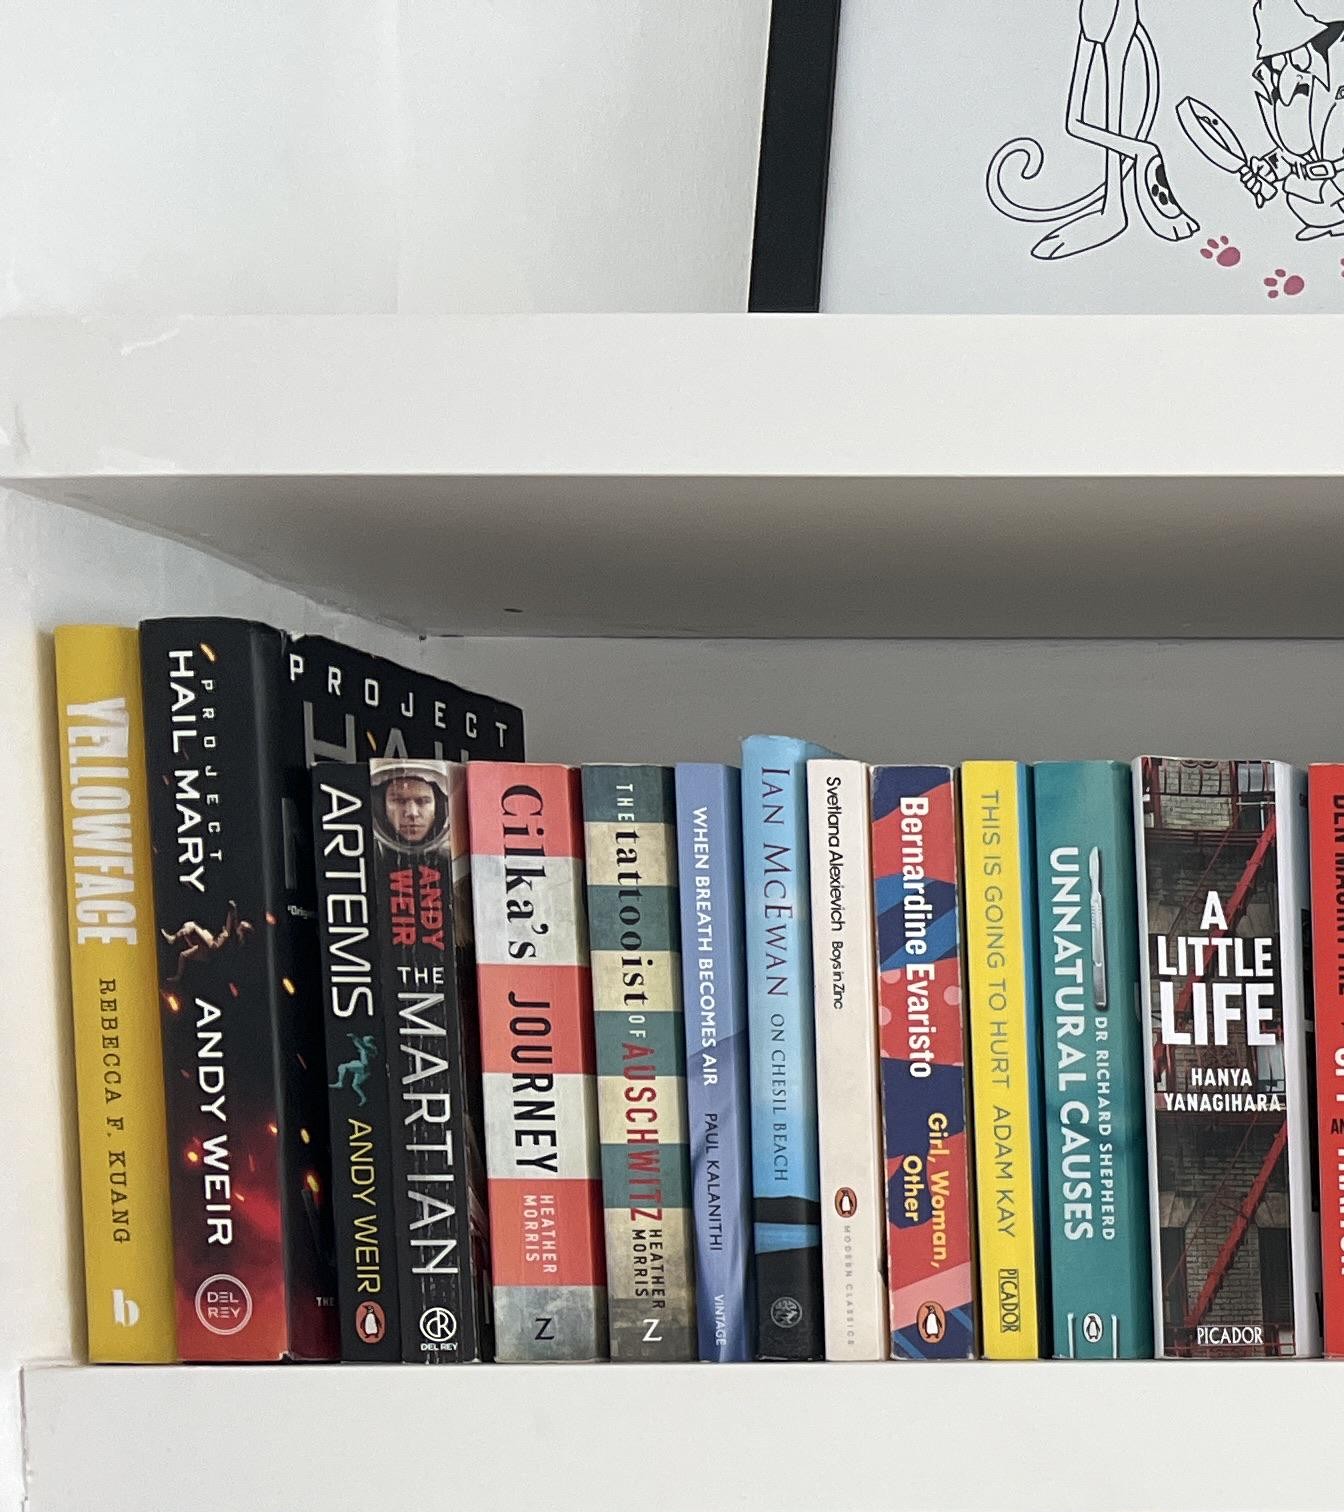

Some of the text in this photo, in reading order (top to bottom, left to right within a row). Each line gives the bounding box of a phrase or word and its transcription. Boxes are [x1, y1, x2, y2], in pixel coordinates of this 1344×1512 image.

[65, 698, 138, 946] YELLOWFACE
[168, 649, 206, 892] HAIL MARY
[319, 784, 374, 1018] ARTEMIS
[500, 785, 548, 961] Cilka's
[692, 808, 718, 1086] WHEN BREATH BECOMES AIR
[899, 798, 936, 1080] Bernardine Evaristo
[1159, 938, 1273, 976] LITTLE
[1201, 891, 1229, 930] A
[398, 968, 445, 985] THE
[1048, 846, 1094, 1240] UNNATURAL CAUSES
[1161, 982, 1276, 1046] LIFE
[98, 977, 131, 1244] REBECCA F. KUANG
[398, 992, 458, 1277] MARTIAN
[508, 991, 559, 1174] JOURNEY
[1164, 1092, 1282, 1112] YANAGIHARA
[1191, 1068, 1252, 1089] HANYA
[421, 1342, 458, 1351] DEL REY
[1198, 1325, 1262, 1345] PICADOR
